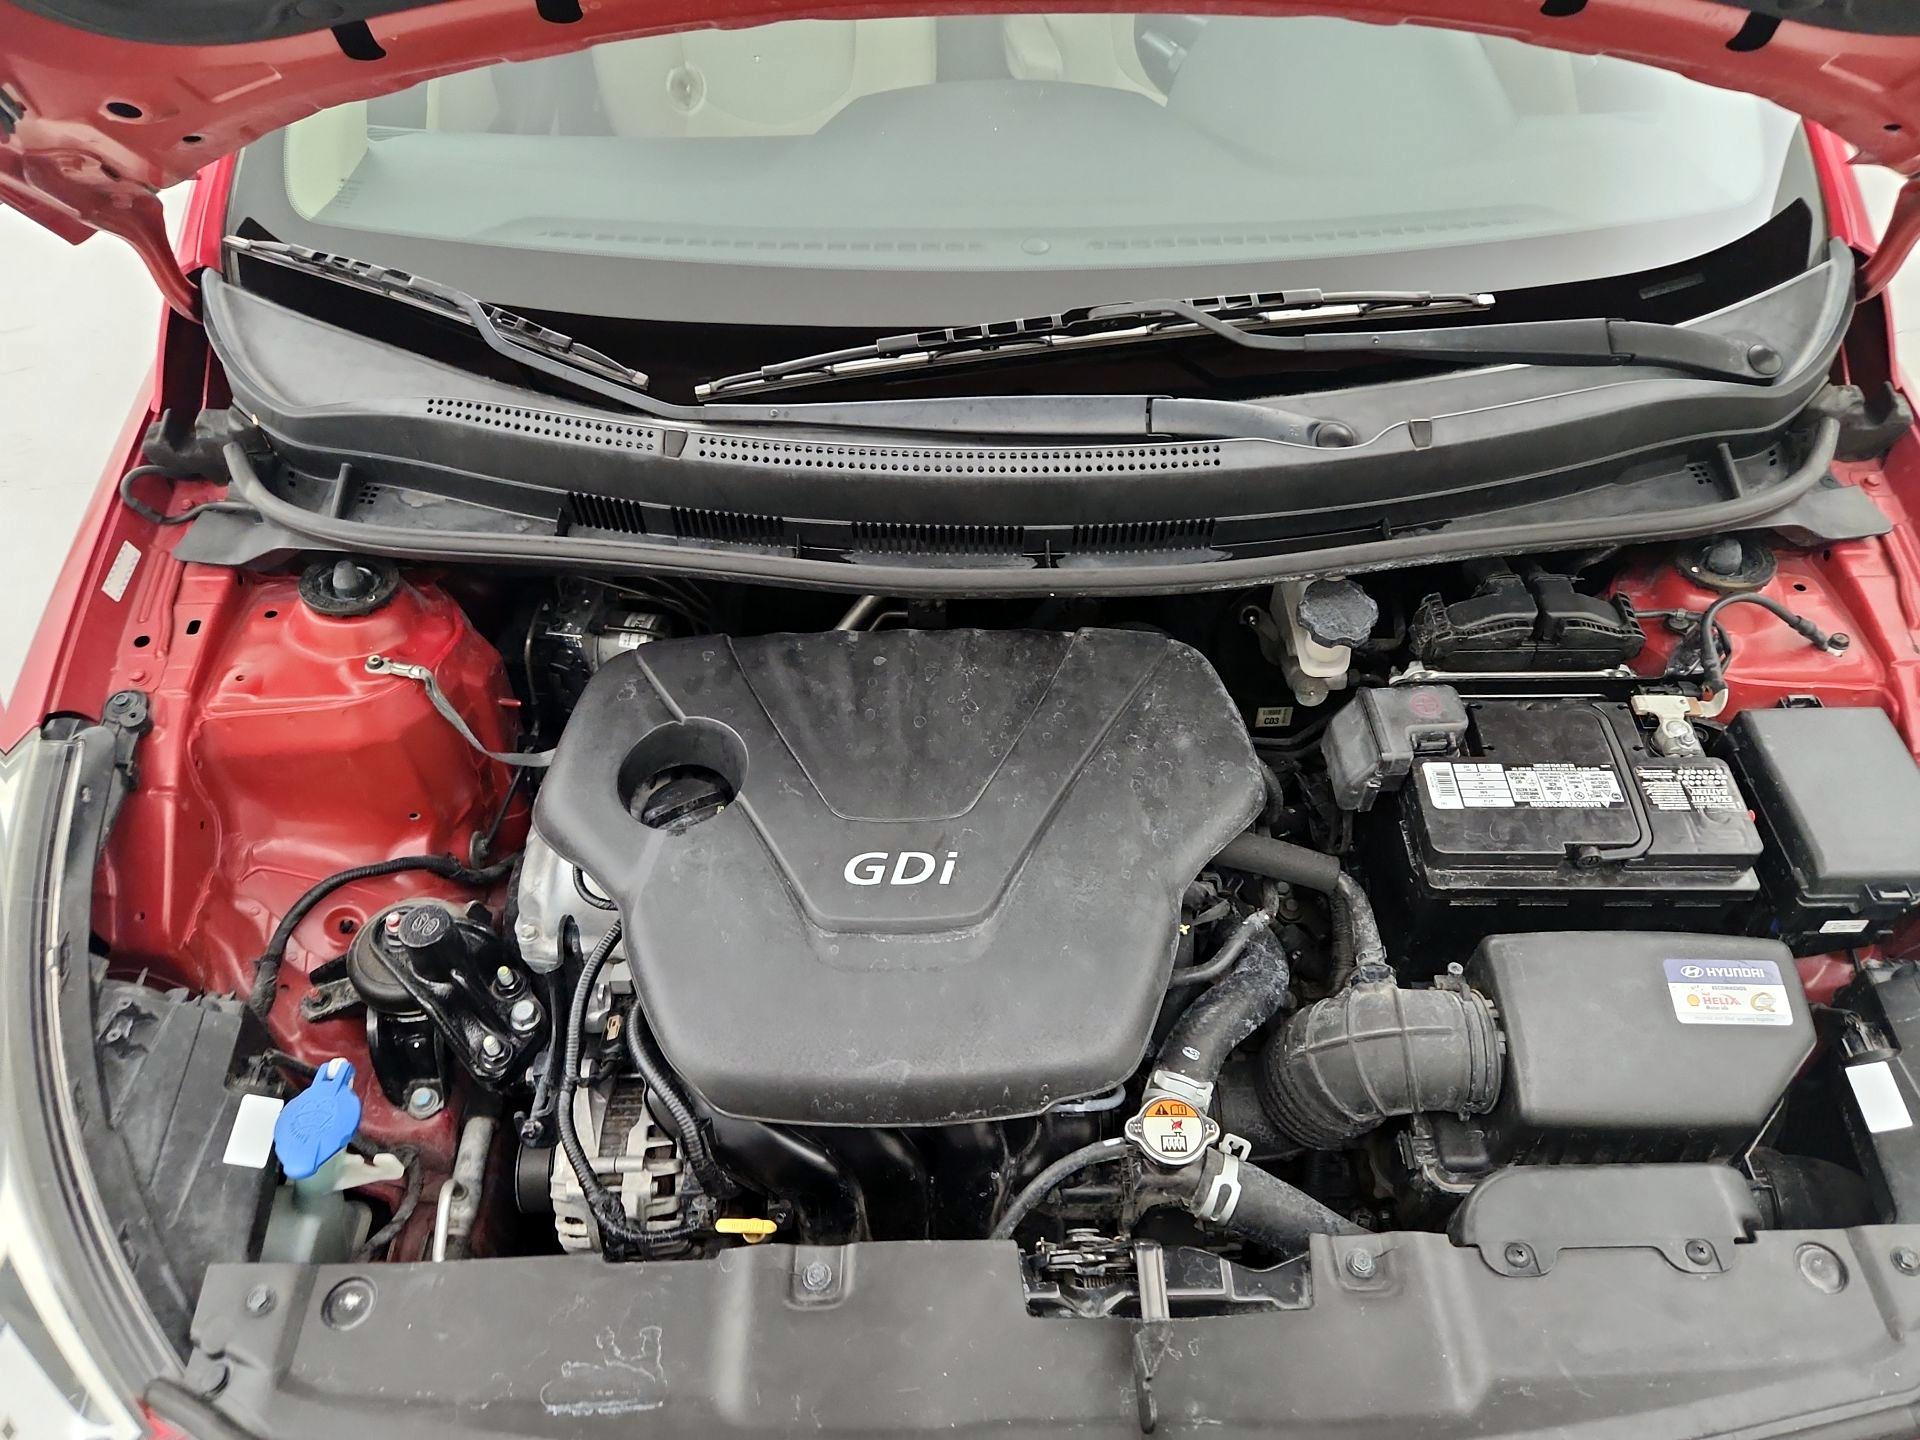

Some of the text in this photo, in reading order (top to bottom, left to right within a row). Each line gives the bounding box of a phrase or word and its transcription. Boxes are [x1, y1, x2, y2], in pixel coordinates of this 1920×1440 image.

[843, 851, 958, 886] GDi
[1705, 967, 1766, 978] HYUNDAI
[1702, 995, 1740, 1006] HELIX
